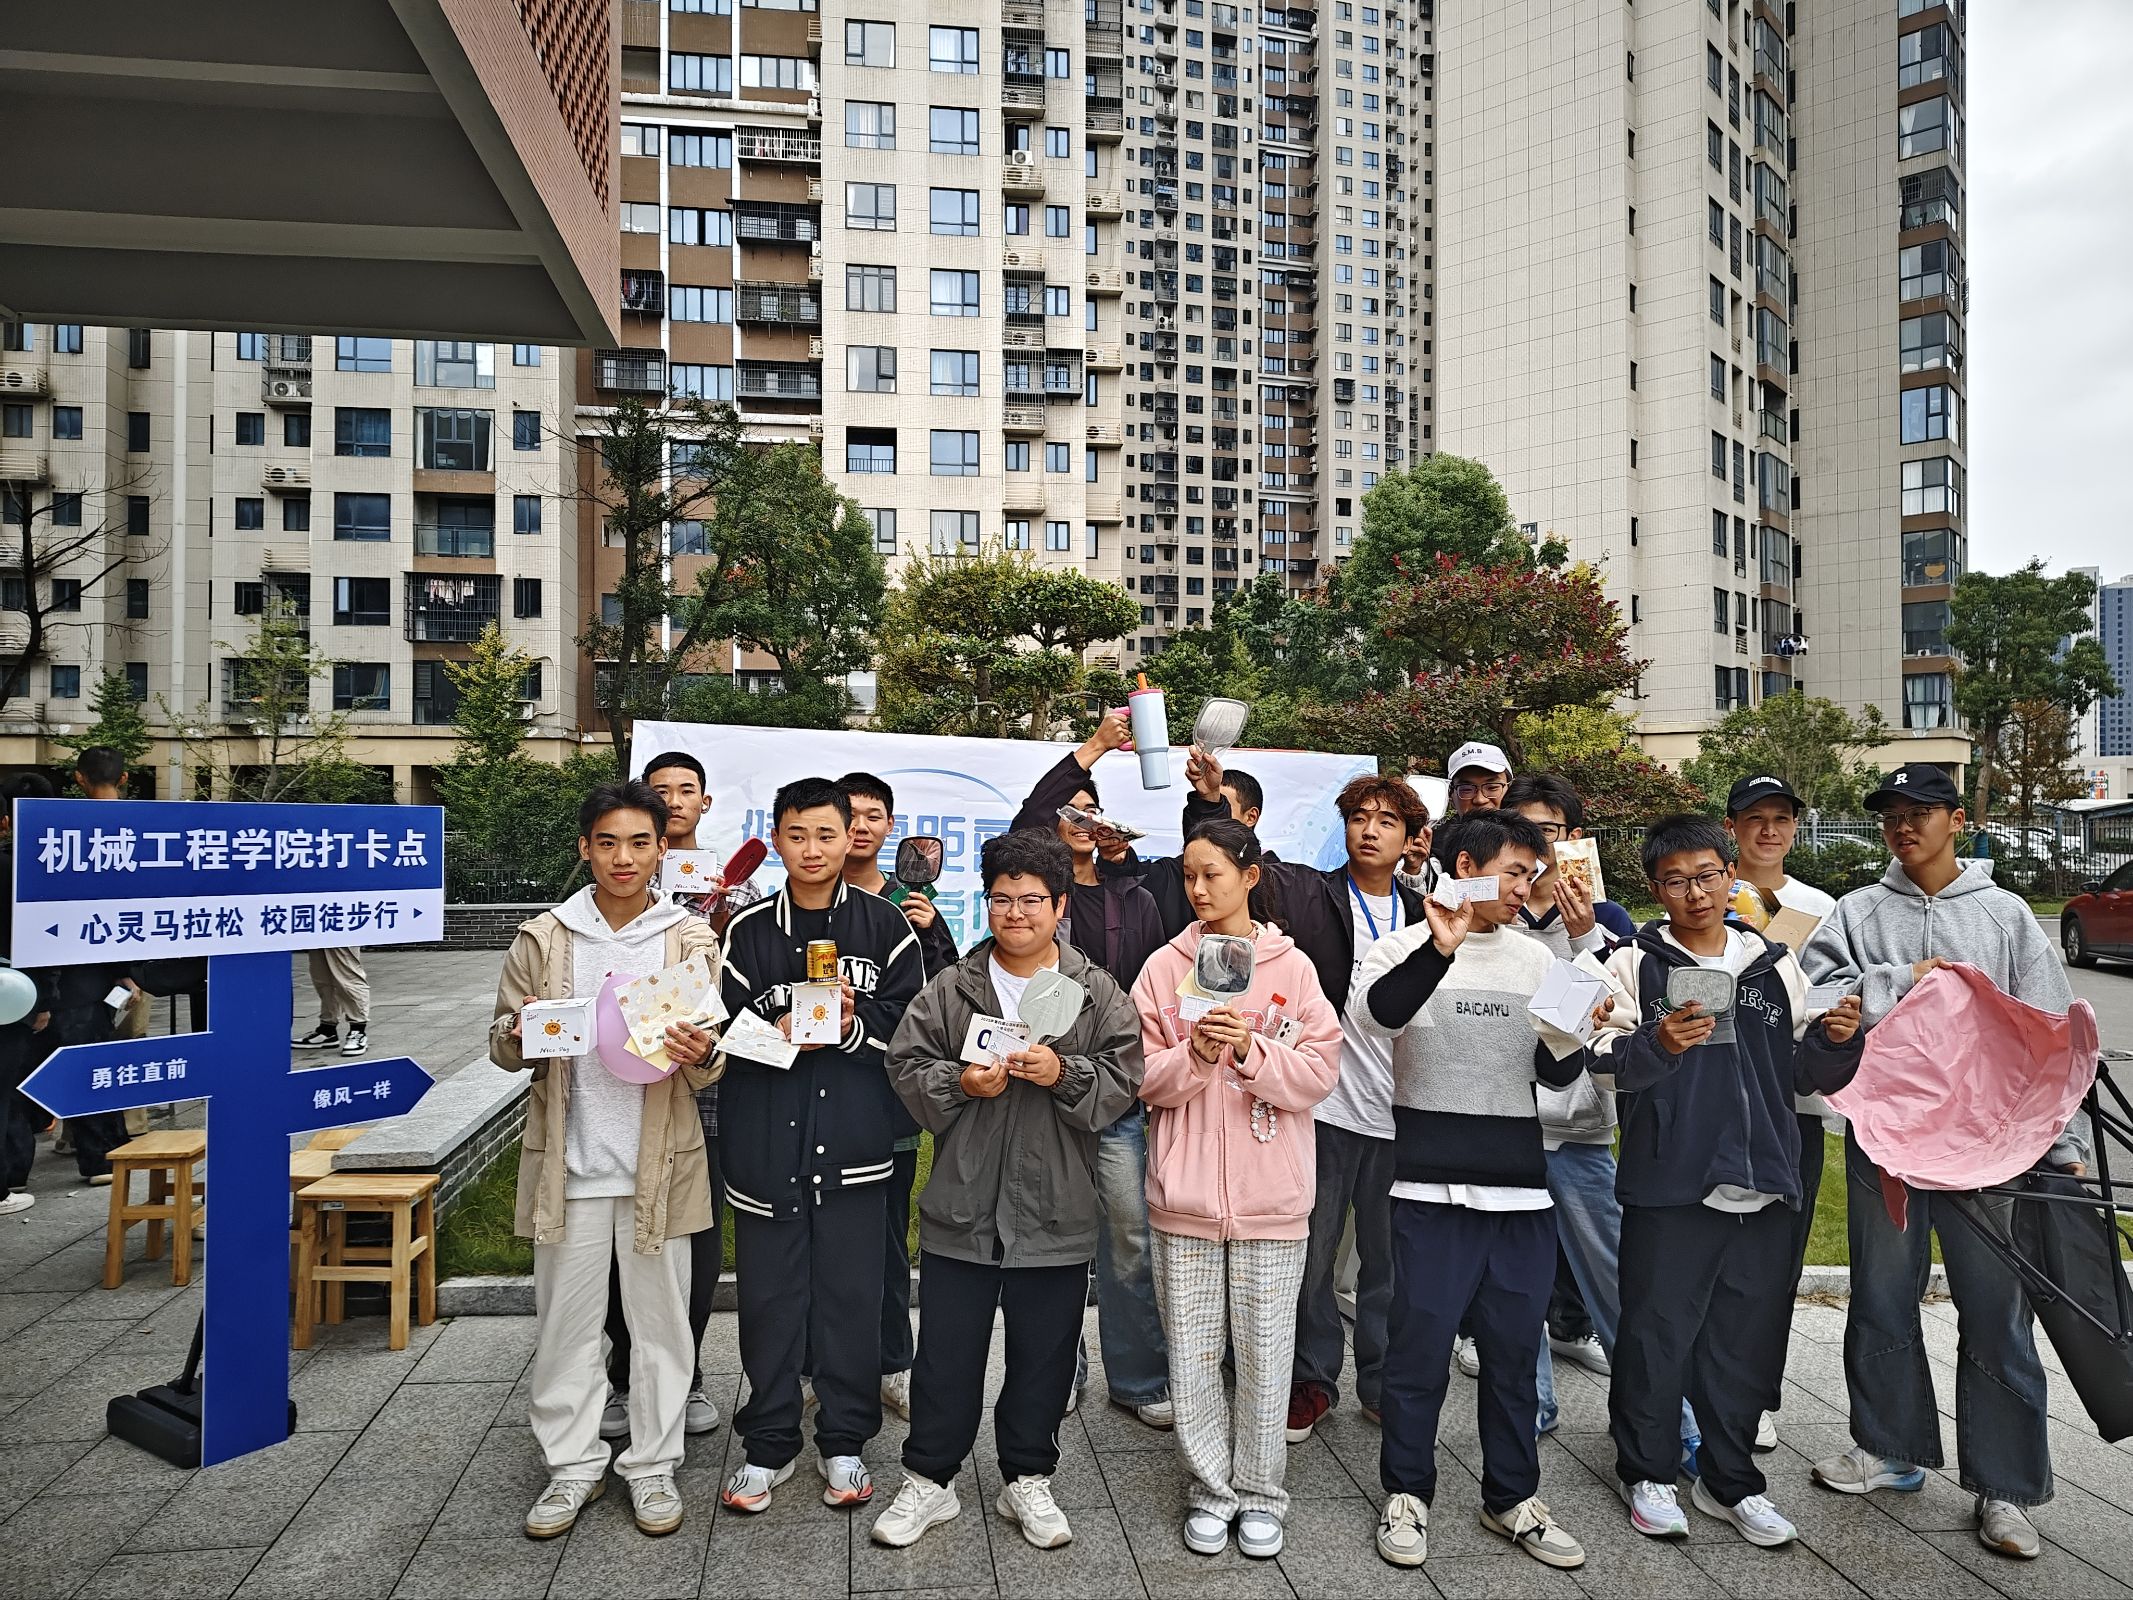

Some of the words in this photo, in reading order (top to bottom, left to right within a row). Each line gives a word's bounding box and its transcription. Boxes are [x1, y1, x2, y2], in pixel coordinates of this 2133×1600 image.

[1894, 773, 1908, 786] R
[38, 827, 428, 874] 机械工程学院打卡点
[80, 907, 244, 945] 心灵马拉松
[260, 901, 399, 936] 校园徒步行
[1456, 1001, 1510, 1018] BAICAIYU
[91, 1058, 188, 1090] 勇往直前
[312, 1080, 392, 1110] 像风一样
